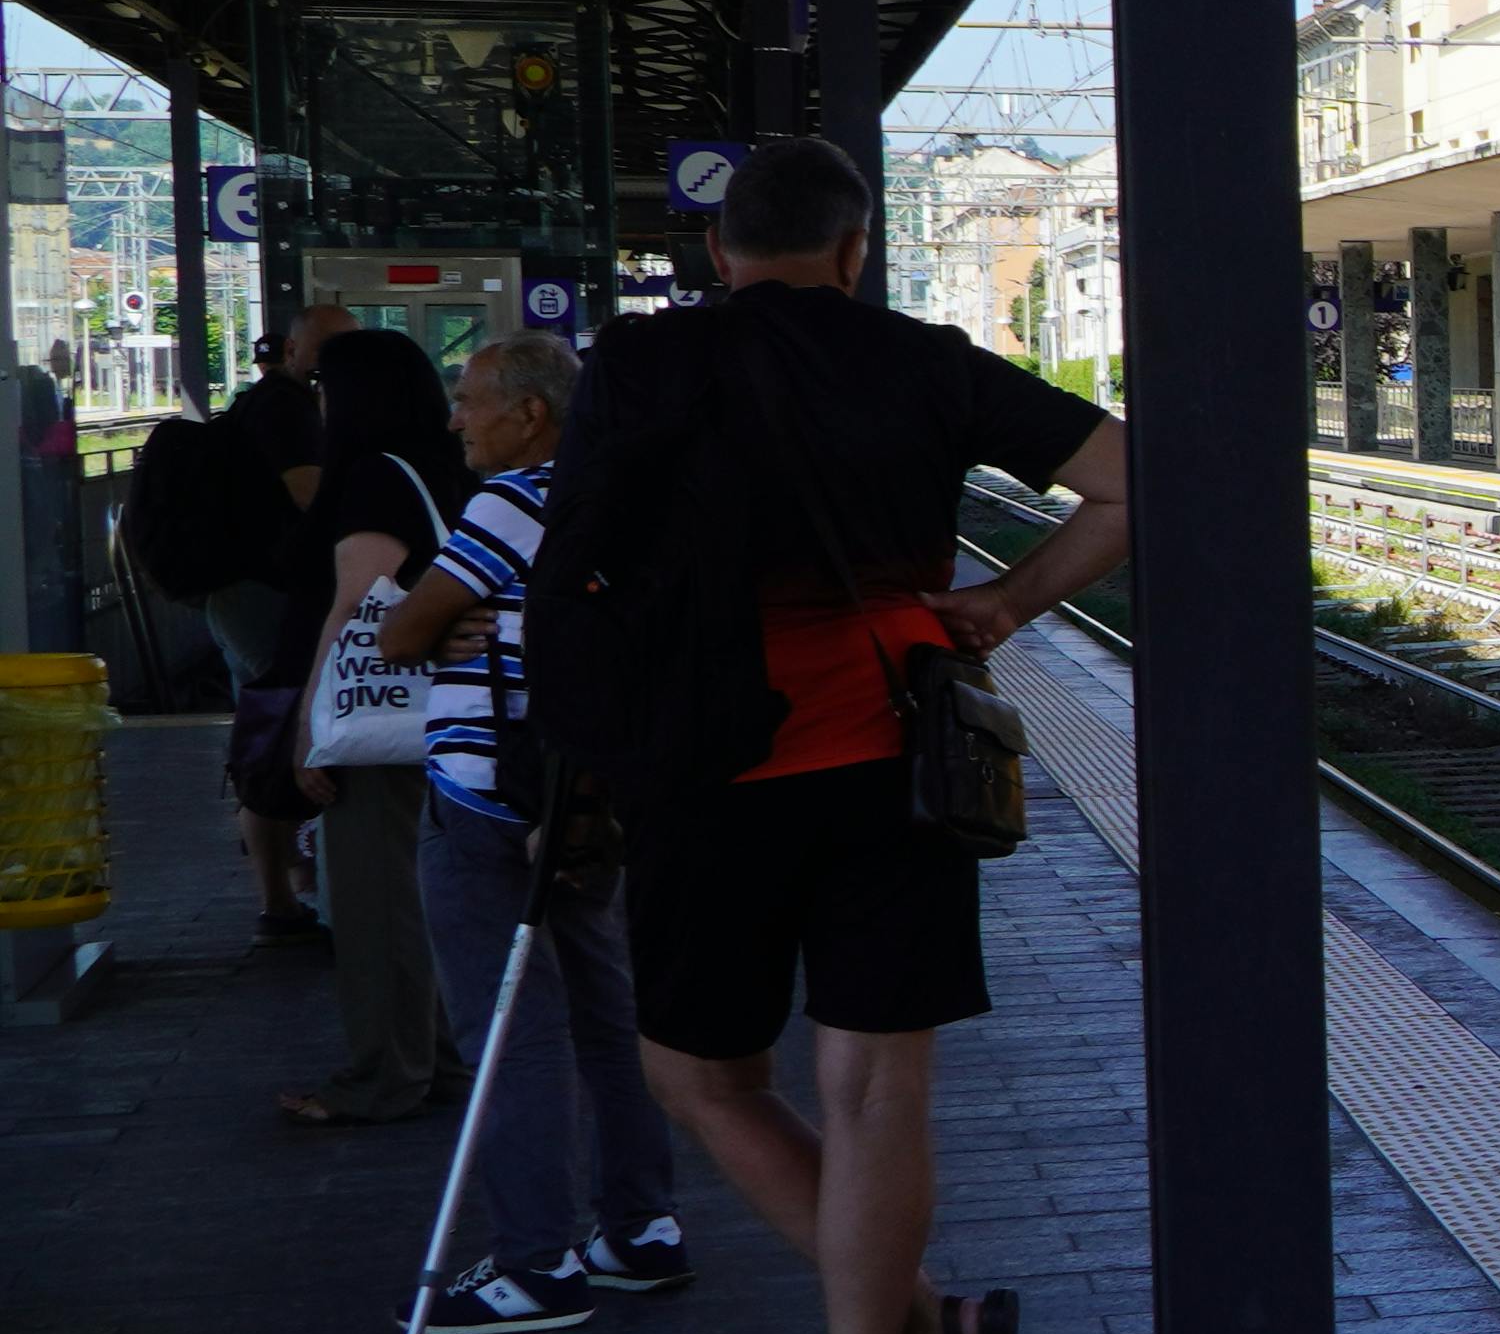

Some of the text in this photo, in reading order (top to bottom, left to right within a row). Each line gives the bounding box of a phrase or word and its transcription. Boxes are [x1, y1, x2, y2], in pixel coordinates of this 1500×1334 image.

[236, 184, 257, 225] 3
[1317, 306, 1327, 324] 1
[337, 630, 375, 659] yo
[336, 678, 409, 718] give
